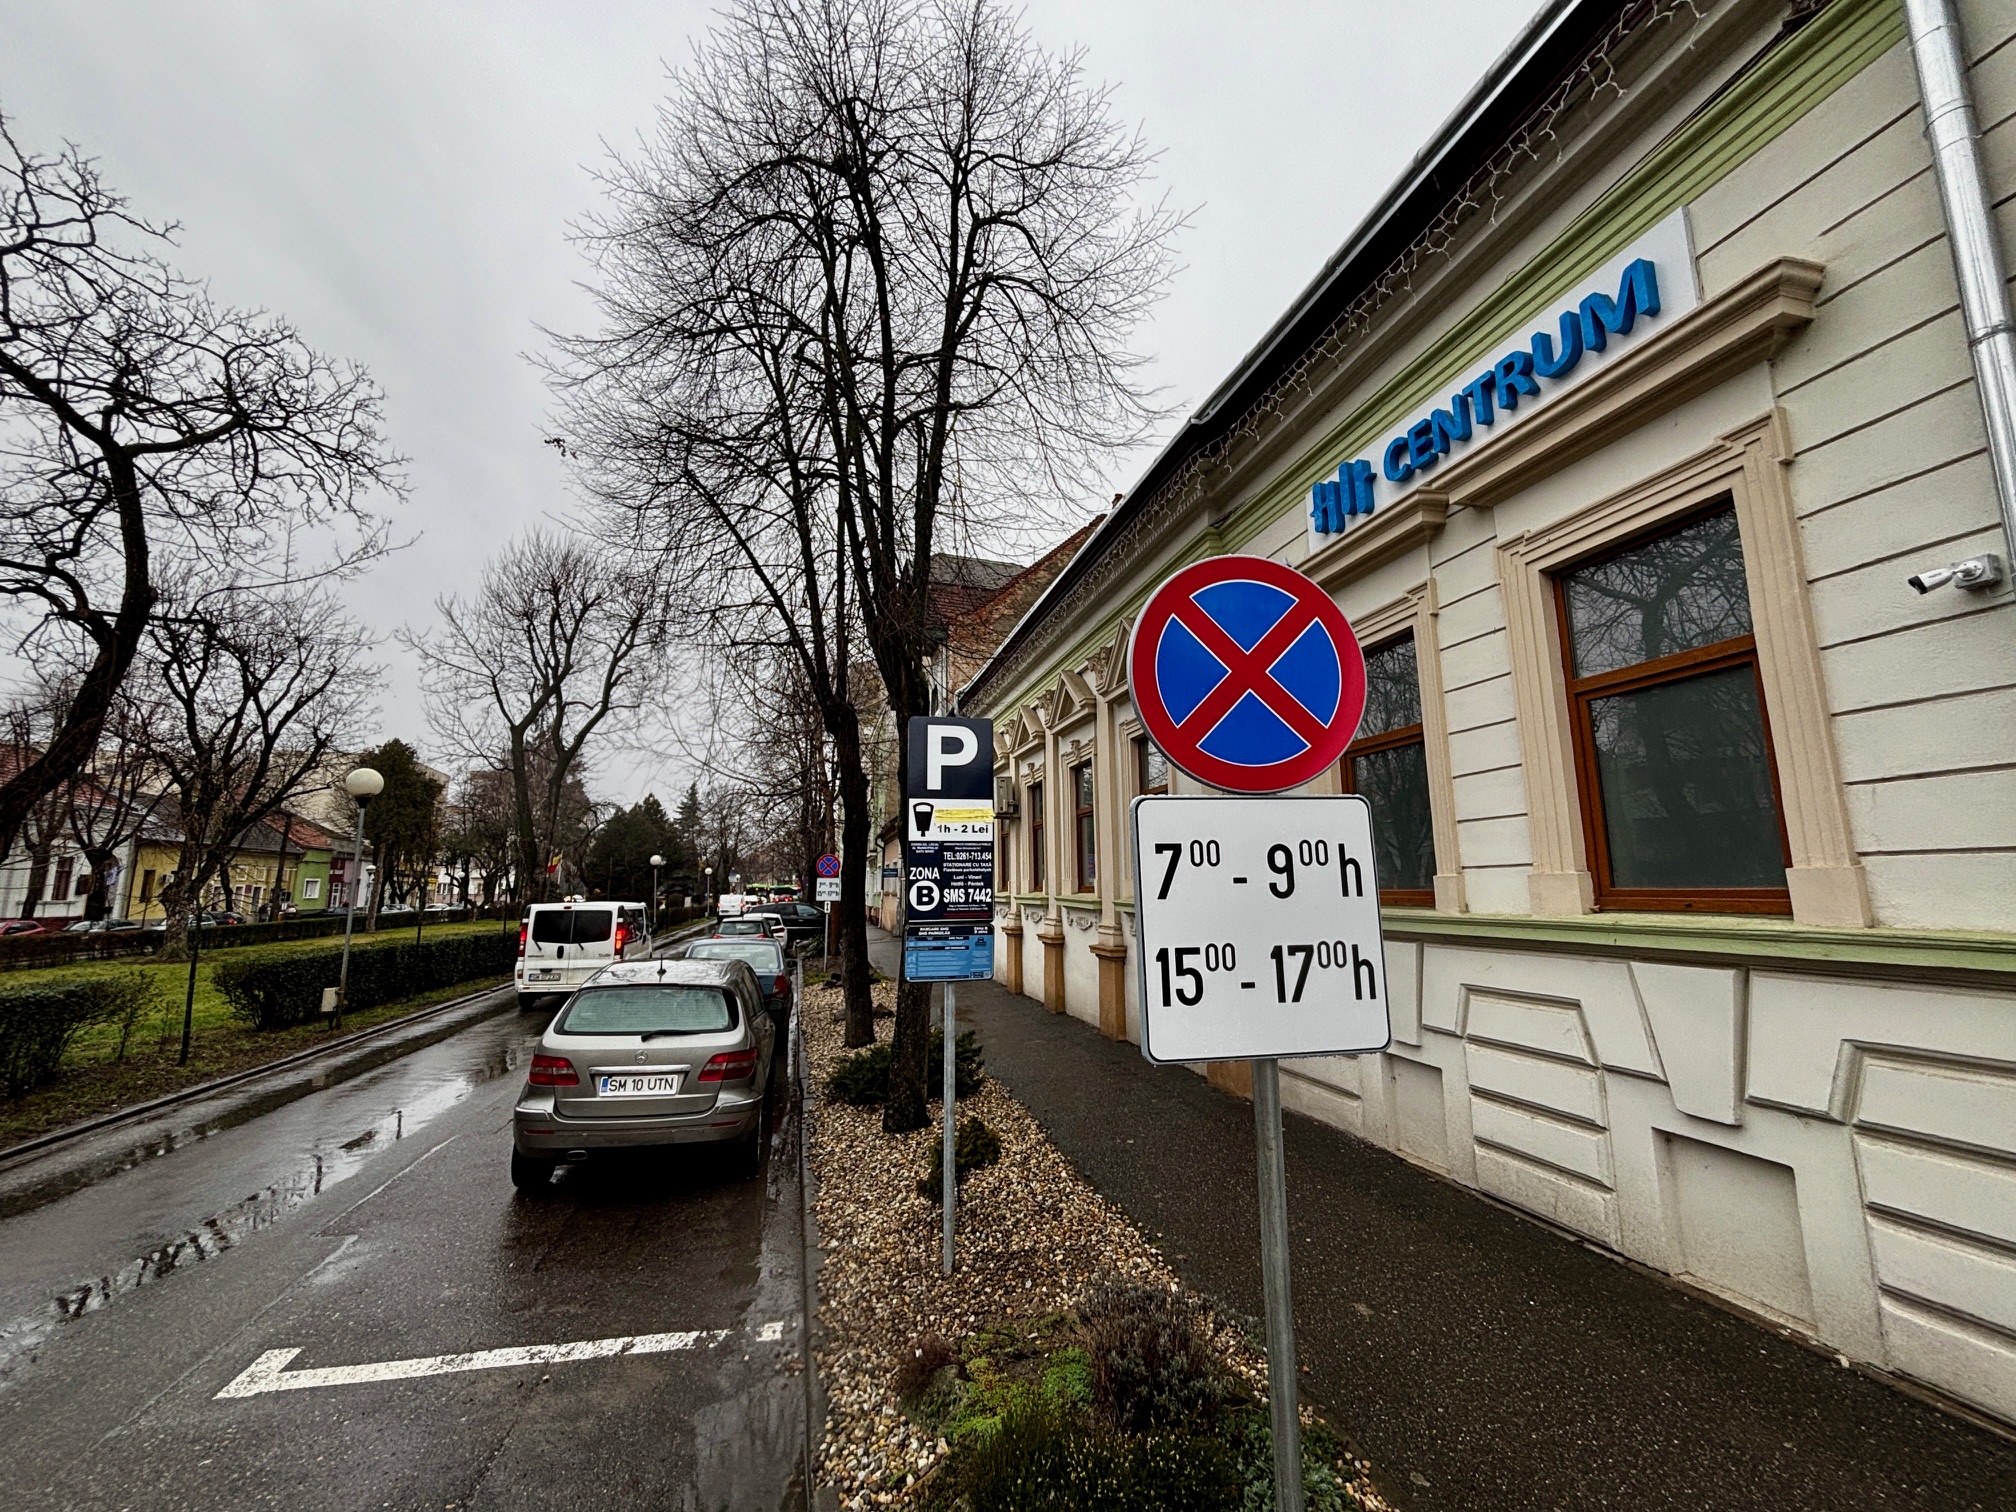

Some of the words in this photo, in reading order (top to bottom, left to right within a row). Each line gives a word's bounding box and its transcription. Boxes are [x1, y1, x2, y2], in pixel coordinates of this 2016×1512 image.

[1383, 257, 1661, 483] CENTRUM
[926, 724, 979, 791] P
[937, 824, 951, 834] 1h
[961, 824, 968, 833] 2
[972, 824, 989, 834] Lei
[909, 866, 941, 880] ZONA
[1338, 842, 1364, 898] h
[916, 885, 935, 906] B
[943, 888, 966, 903] SMS
[968, 888, 992, 903] 7442
[1352, 943, 1377, 1001] h
[608, 1079, 627, 1092] SM
[632, 1078, 644, 1091] 10
[647, 1077, 674, 1091] UTN
